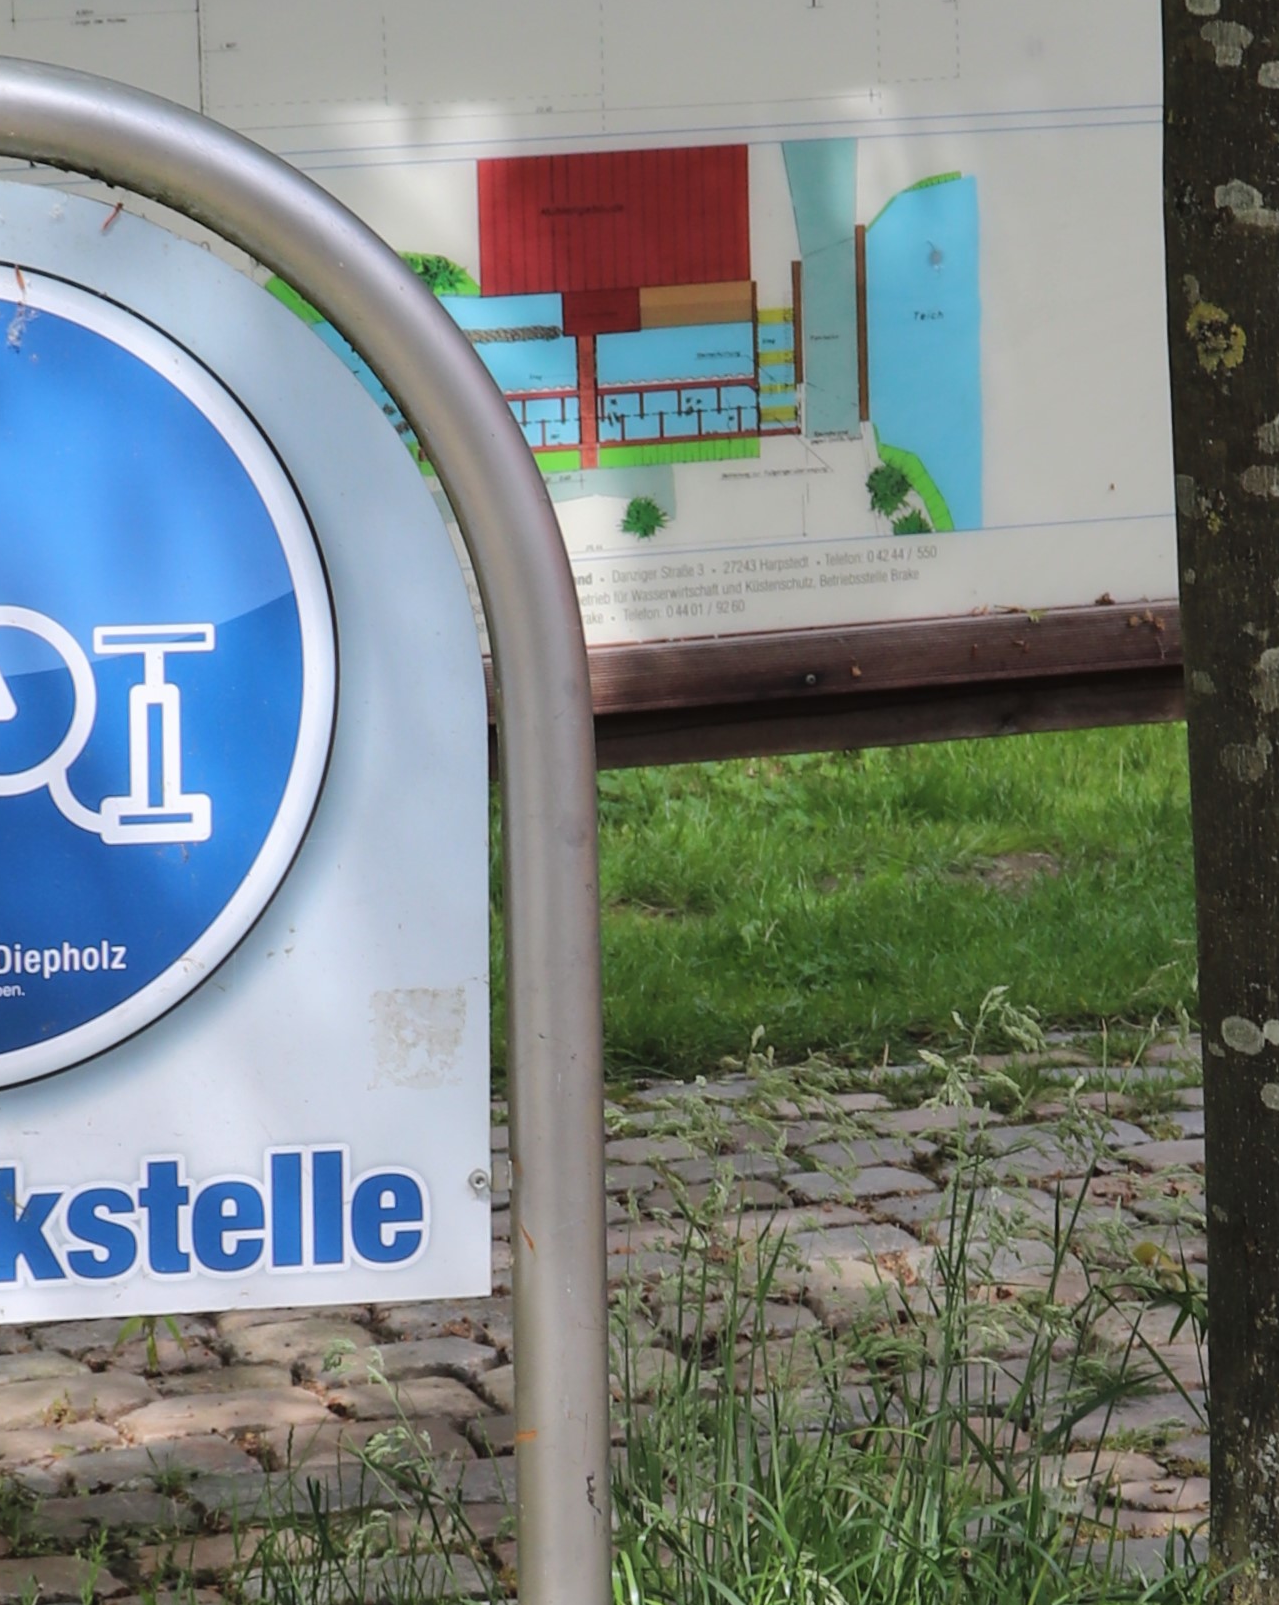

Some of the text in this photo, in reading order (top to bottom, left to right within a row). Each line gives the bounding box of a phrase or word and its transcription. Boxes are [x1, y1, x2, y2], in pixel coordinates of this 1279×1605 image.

[612, 568, 657, 585] Danziger
[661, 565, 695, 580] Straße
[697, 563, 705, 576] 3
[723, 559, 757, 574] 27243
[759, 555, 809, 572] Harpstedt
[632, 584, 719, 602] Wasserwirtschaft
[722, 581, 742, 595] und
